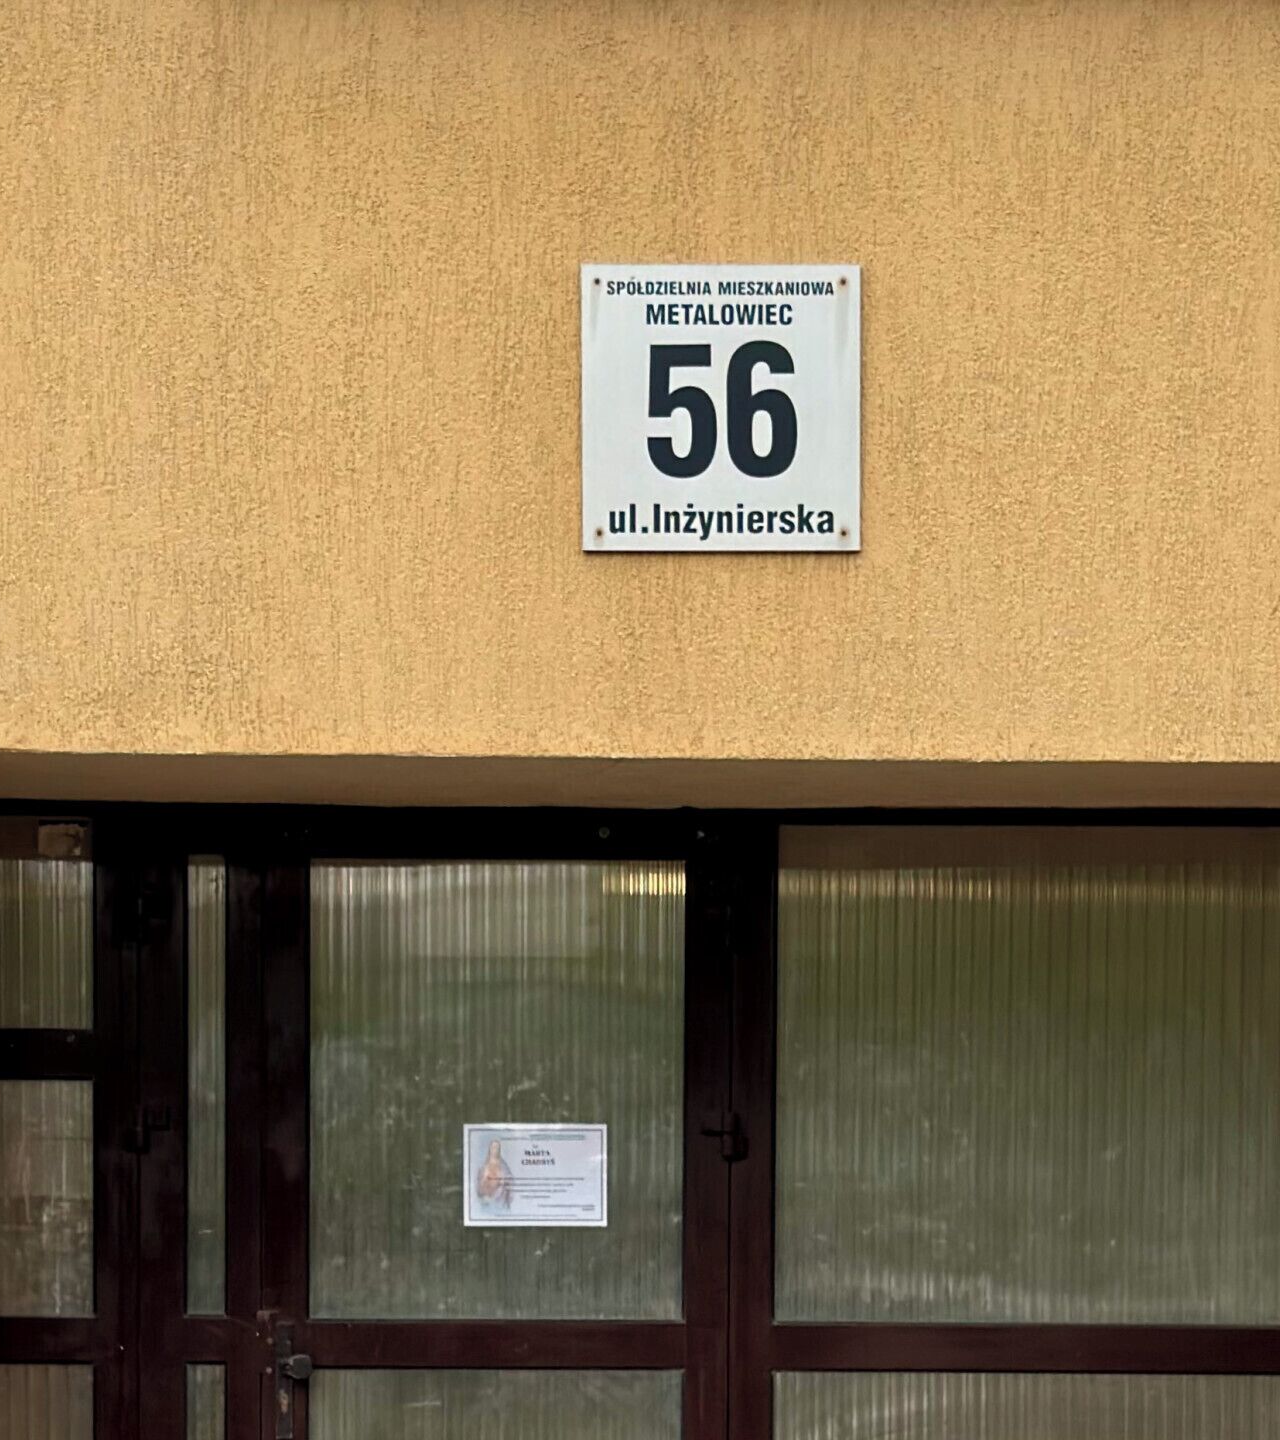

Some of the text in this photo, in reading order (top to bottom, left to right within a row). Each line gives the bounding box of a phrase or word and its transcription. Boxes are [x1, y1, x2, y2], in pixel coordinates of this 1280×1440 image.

[606, 276, 834, 296] SPÓŁDZIELNIA MIESZKANIOWA
[645, 304, 793, 326] METALOWIEC
[647, 340, 798, 479] 56
